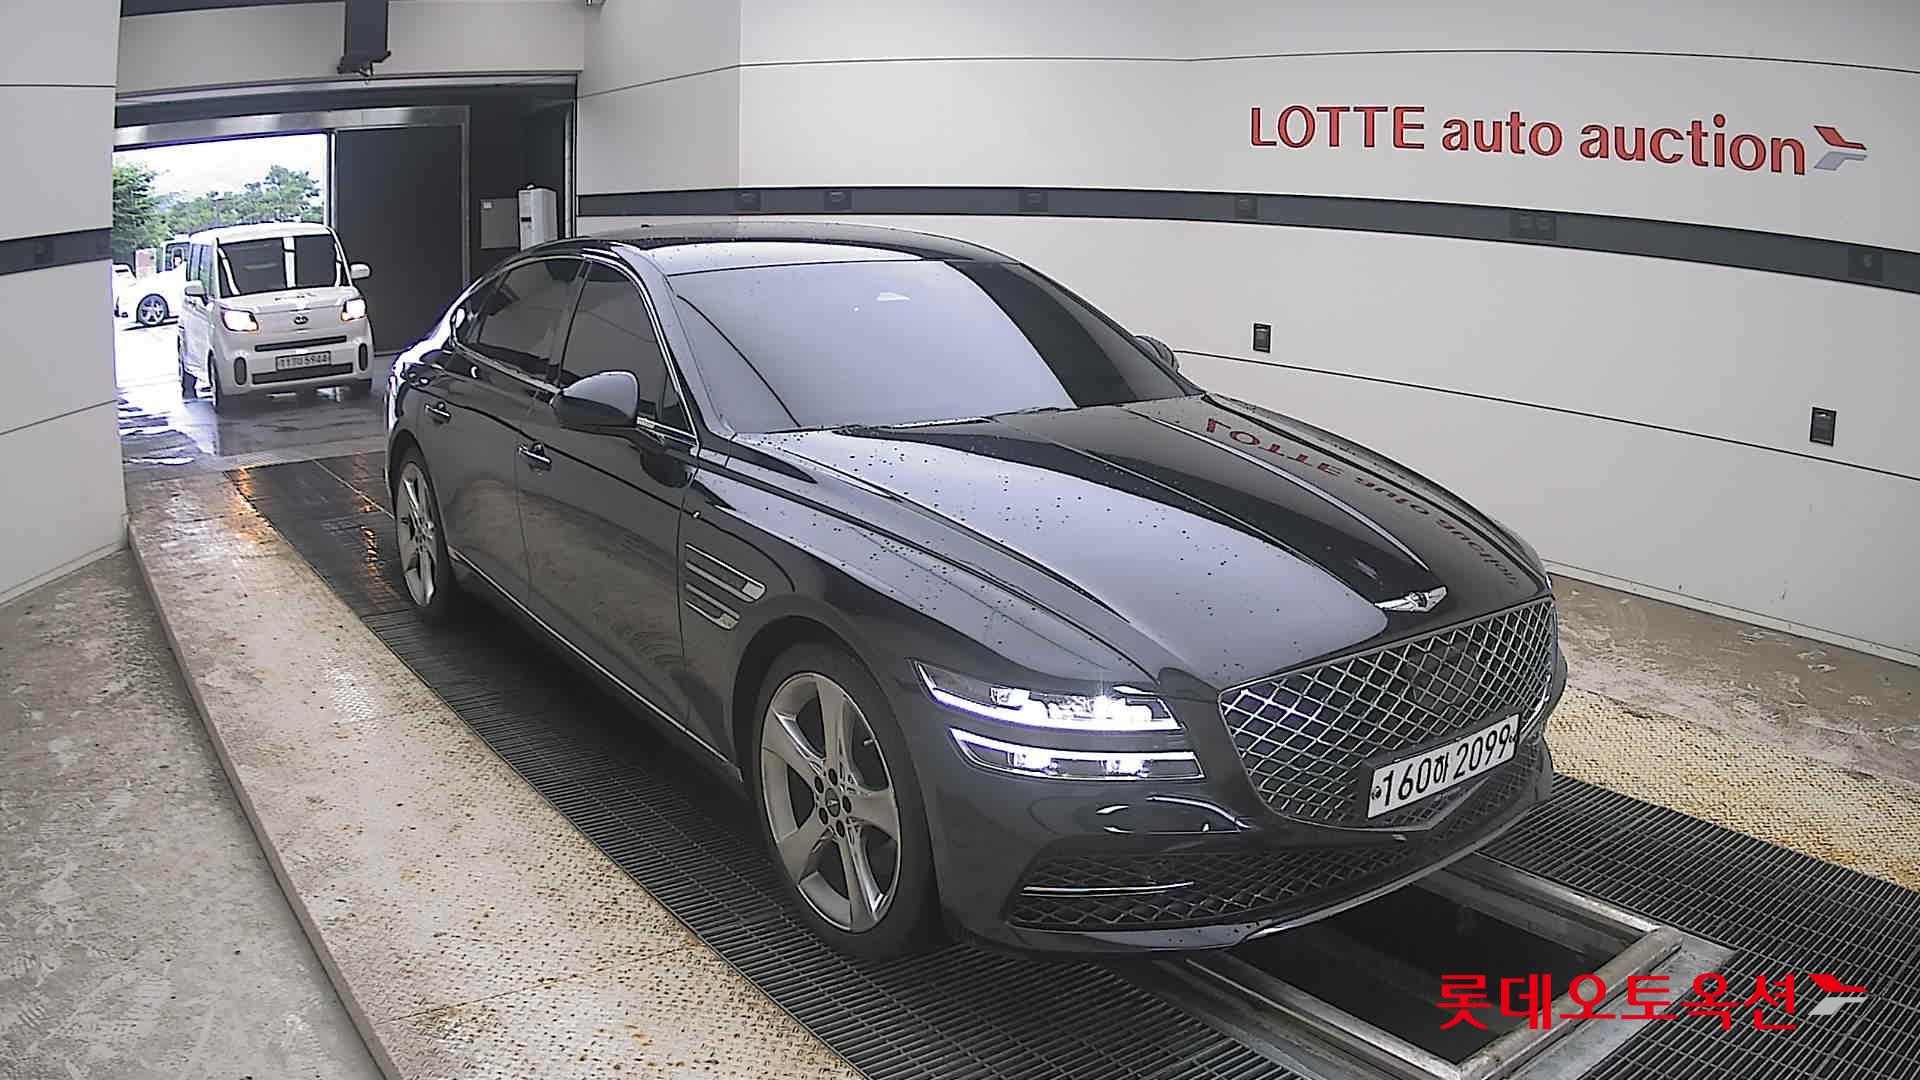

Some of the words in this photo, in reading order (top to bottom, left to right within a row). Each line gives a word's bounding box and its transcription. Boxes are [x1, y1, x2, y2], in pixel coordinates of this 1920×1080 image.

[1250, 106, 1426, 150] LOTTE
[1442, 111, 1563, 158] auto
[1579, 114, 1806, 176] auction
[1383, 751, 1450, 807] 160하
[1453, 724, 1512, 780] 2099
